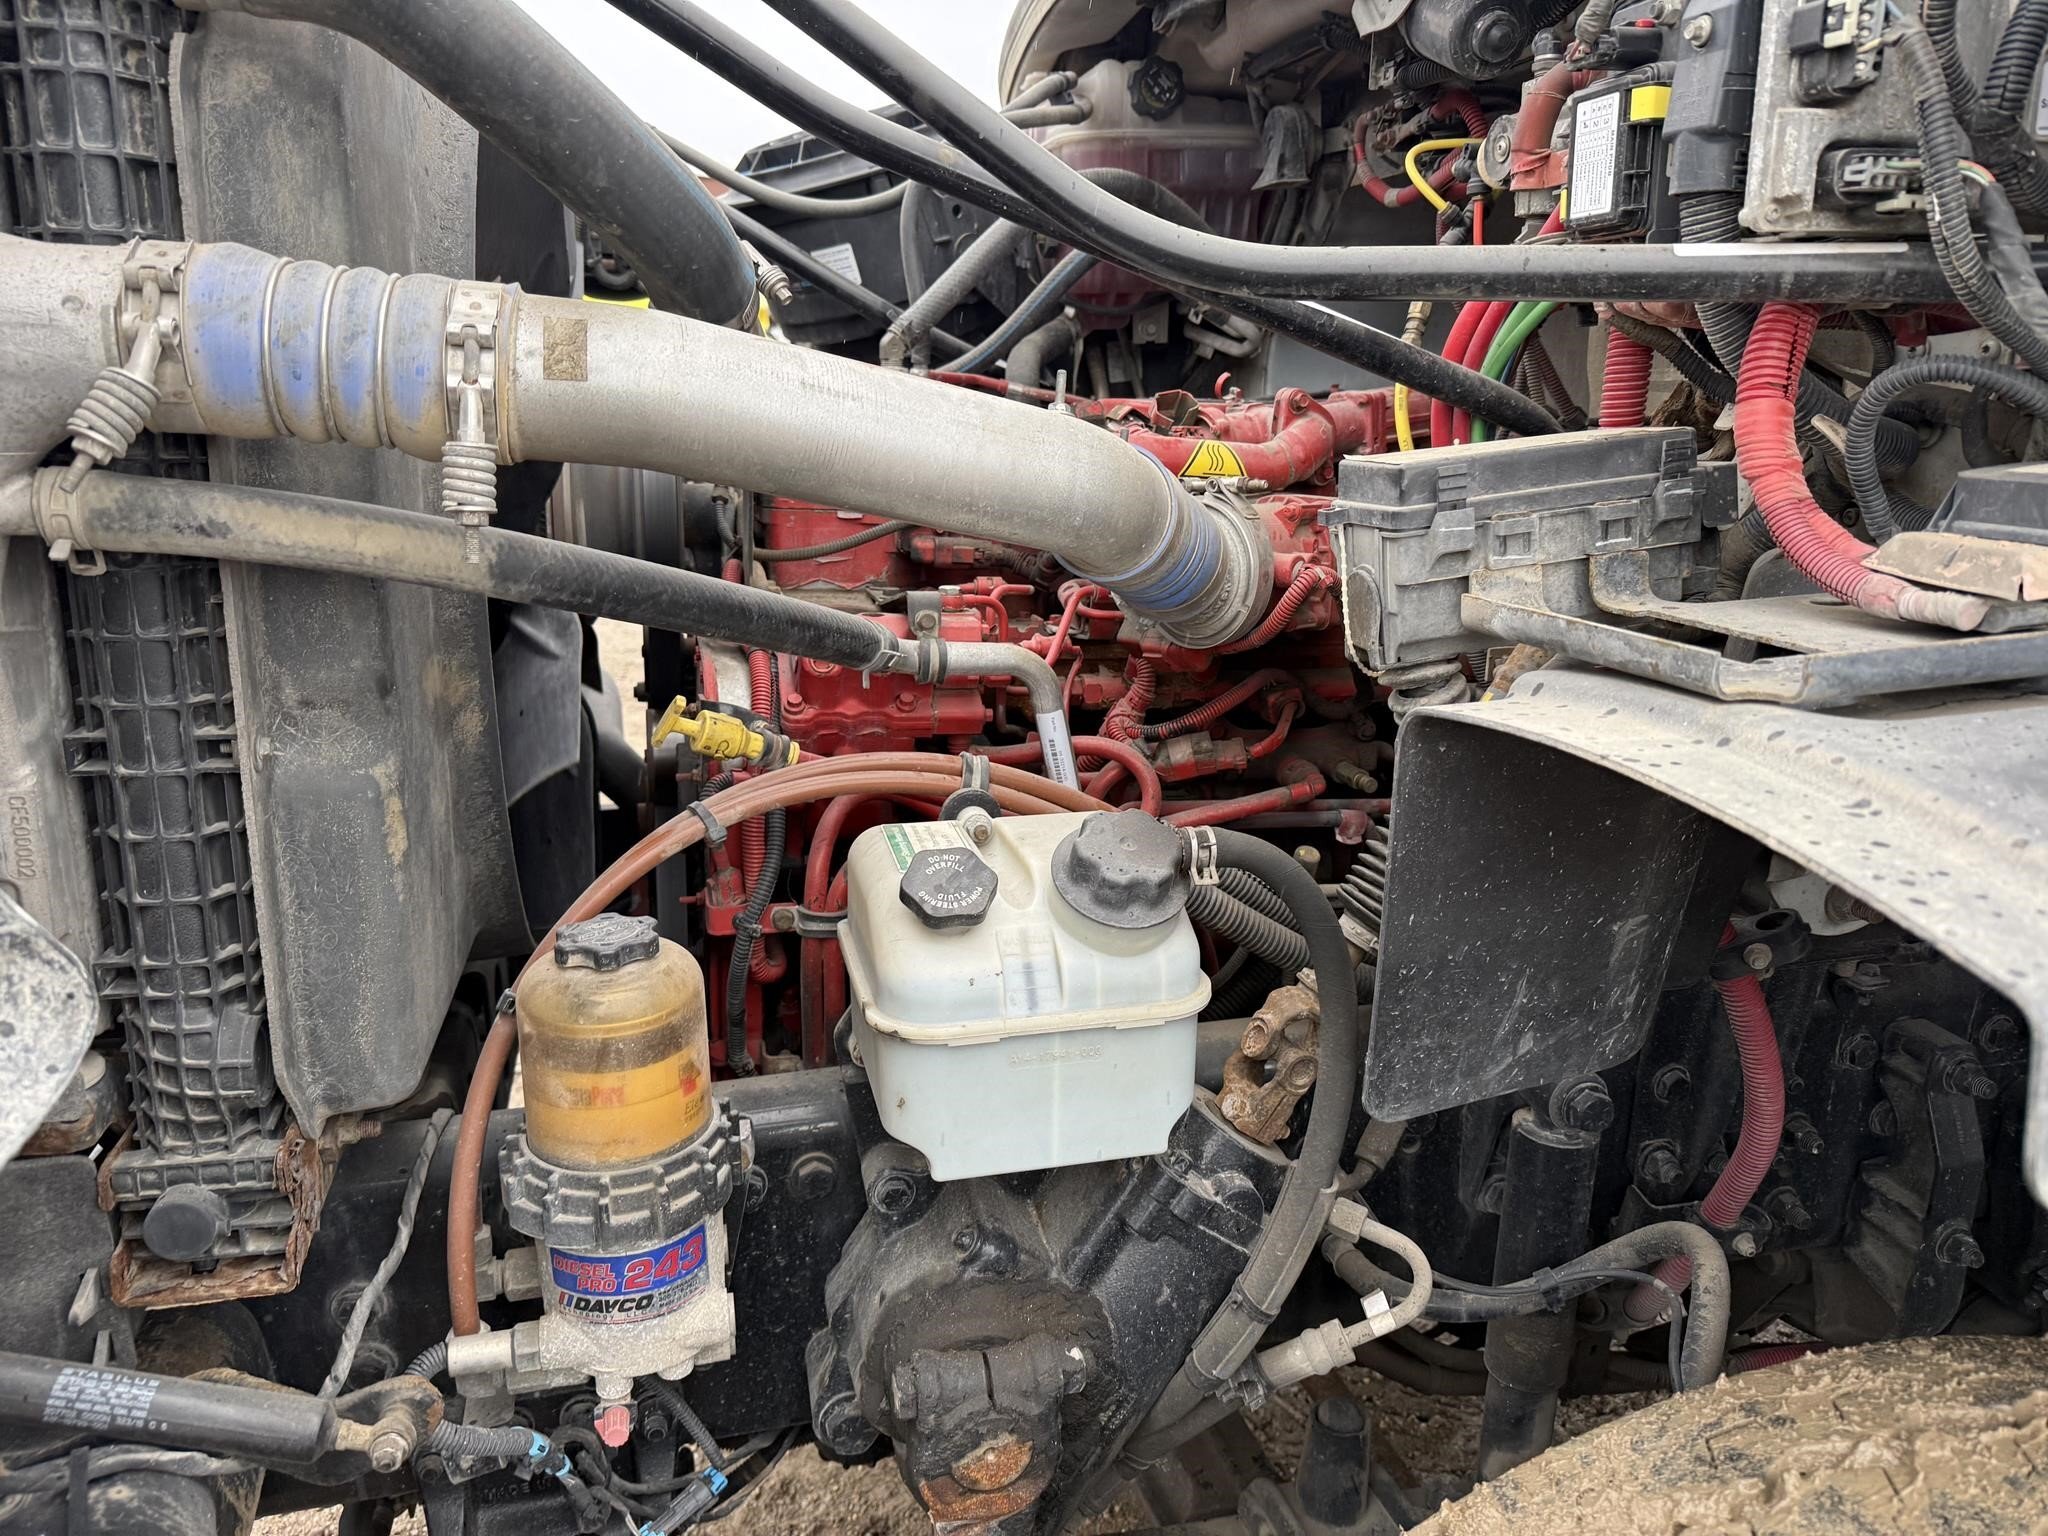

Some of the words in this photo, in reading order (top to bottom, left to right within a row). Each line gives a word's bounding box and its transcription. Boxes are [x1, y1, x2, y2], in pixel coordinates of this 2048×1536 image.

[8, 796, 36, 877] CF500002
[925, 861, 965, 875] OVERFILL
[927, 855, 940, 864] DO
[943, 854, 960, 862] NOT
[918, 890, 959, 909] STEERING
[937, 891, 967, 901] FLUID
[960, 886, 983, 906] POWER
[553, 1254, 616, 1279] DIESEL
[577, 1277, 618, 1293] PRO
[622, 1233, 704, 1292] 243
[61, 1367, 160, 1387] STABILUS
